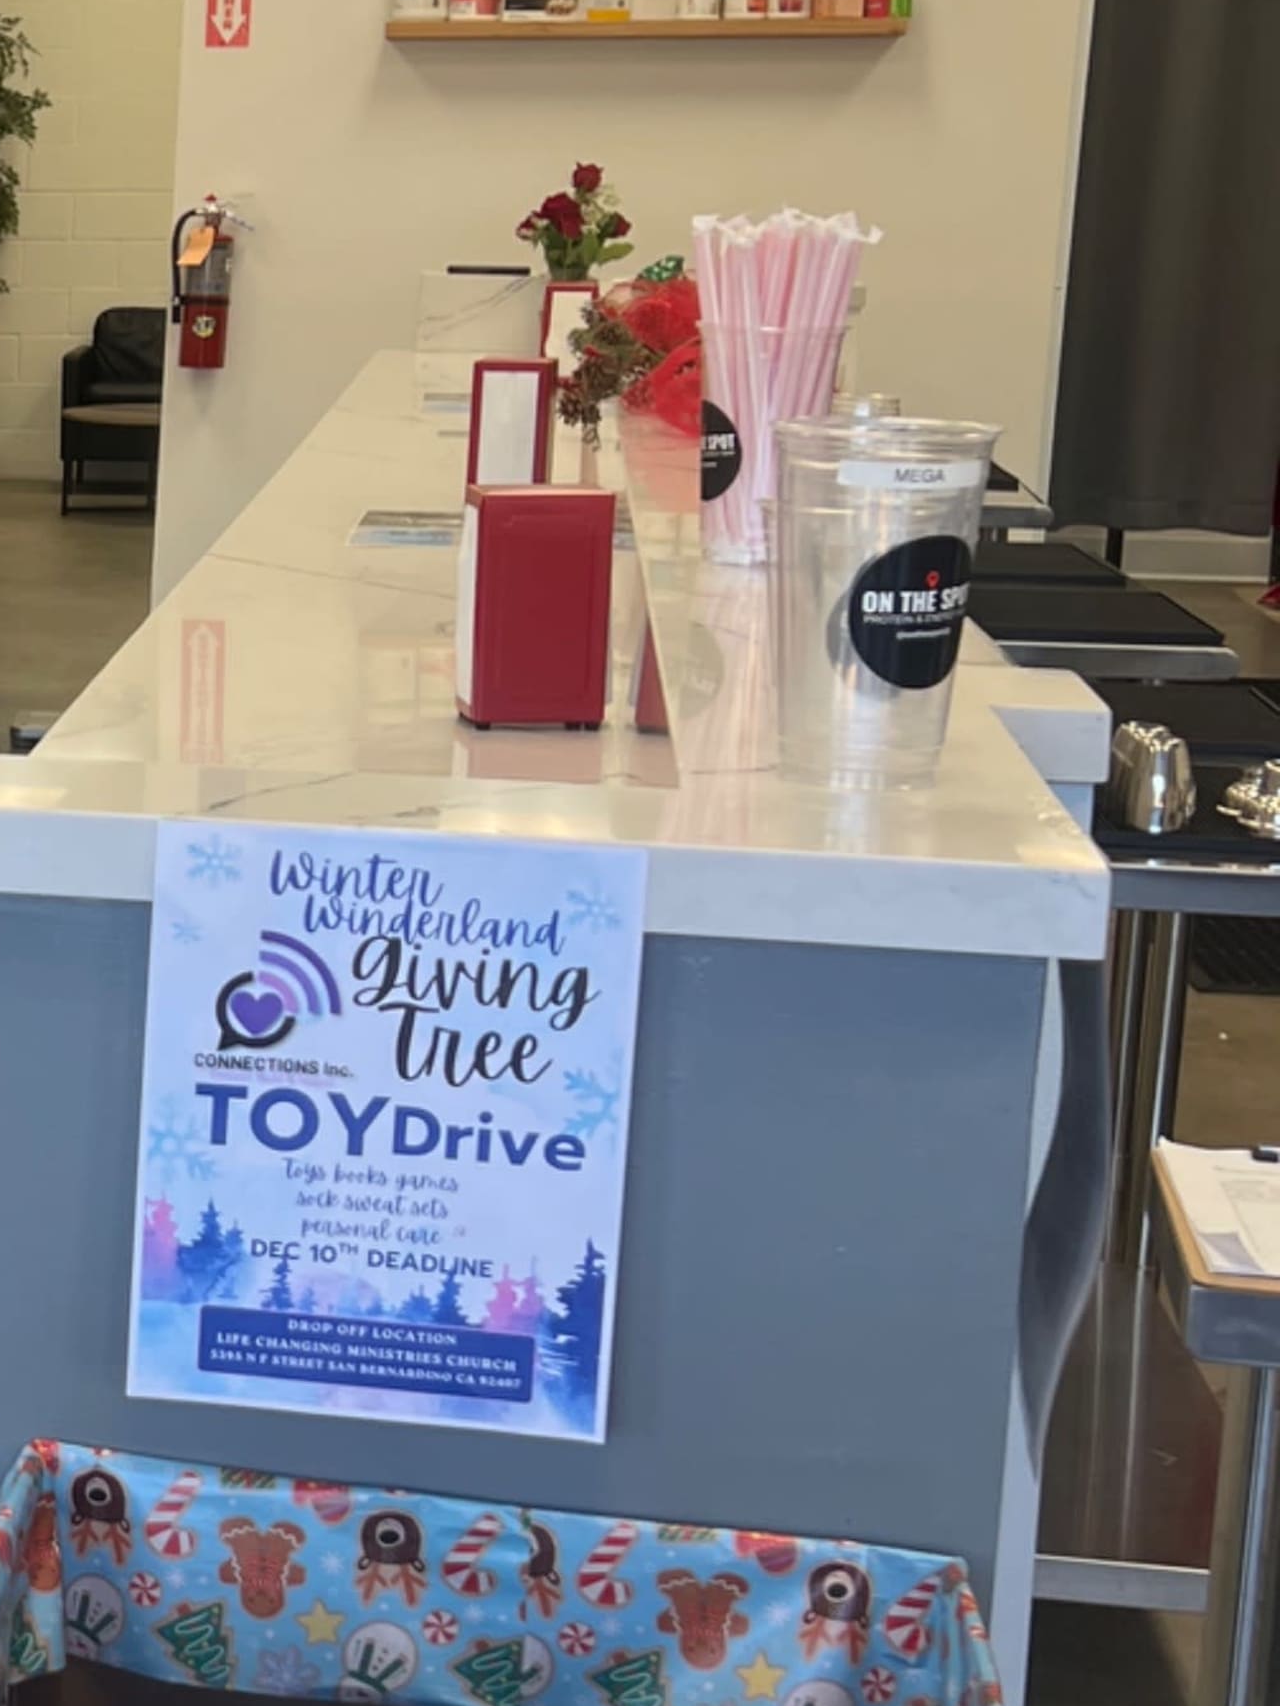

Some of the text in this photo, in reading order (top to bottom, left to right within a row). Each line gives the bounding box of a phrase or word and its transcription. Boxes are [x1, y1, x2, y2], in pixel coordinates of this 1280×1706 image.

[708, 433, 735, 450] SPOT
[894, 468, 946, 483] MEGA
[862, 591, 893, 614] ON
[900, 589, 938, 613] THE
[270, 849, 445, 908] Winter
[378, 1001, 554, 1088] Tree
[193, 1053, 355, 1078] CONNECTIONS Inc.
[282, 1157, 459, 1193] Toys books games
[343, 1193, 407, 1217] sweat
[410, 1197, 449, 1219] sets
[301, 1217, 442, 1246] personal care
[251, 1238, 301, 1260] DEC
[366, 1249, 495, 1278] DEADLINE
[288, 1319, 458, 1344] DROP OFF LOCATION
[217, 1332, 517, 1372] LIFE CHANGING MINISTRIES CHURCH
[246, 1353, 256, 1363] N
[271, 1355, 324, 1369] STREET
[328, 1360, 356, 1373] SAN
[359, 1363, 453, 1382] BERNARDINO
[455, 1373, 476, 1385] CA
